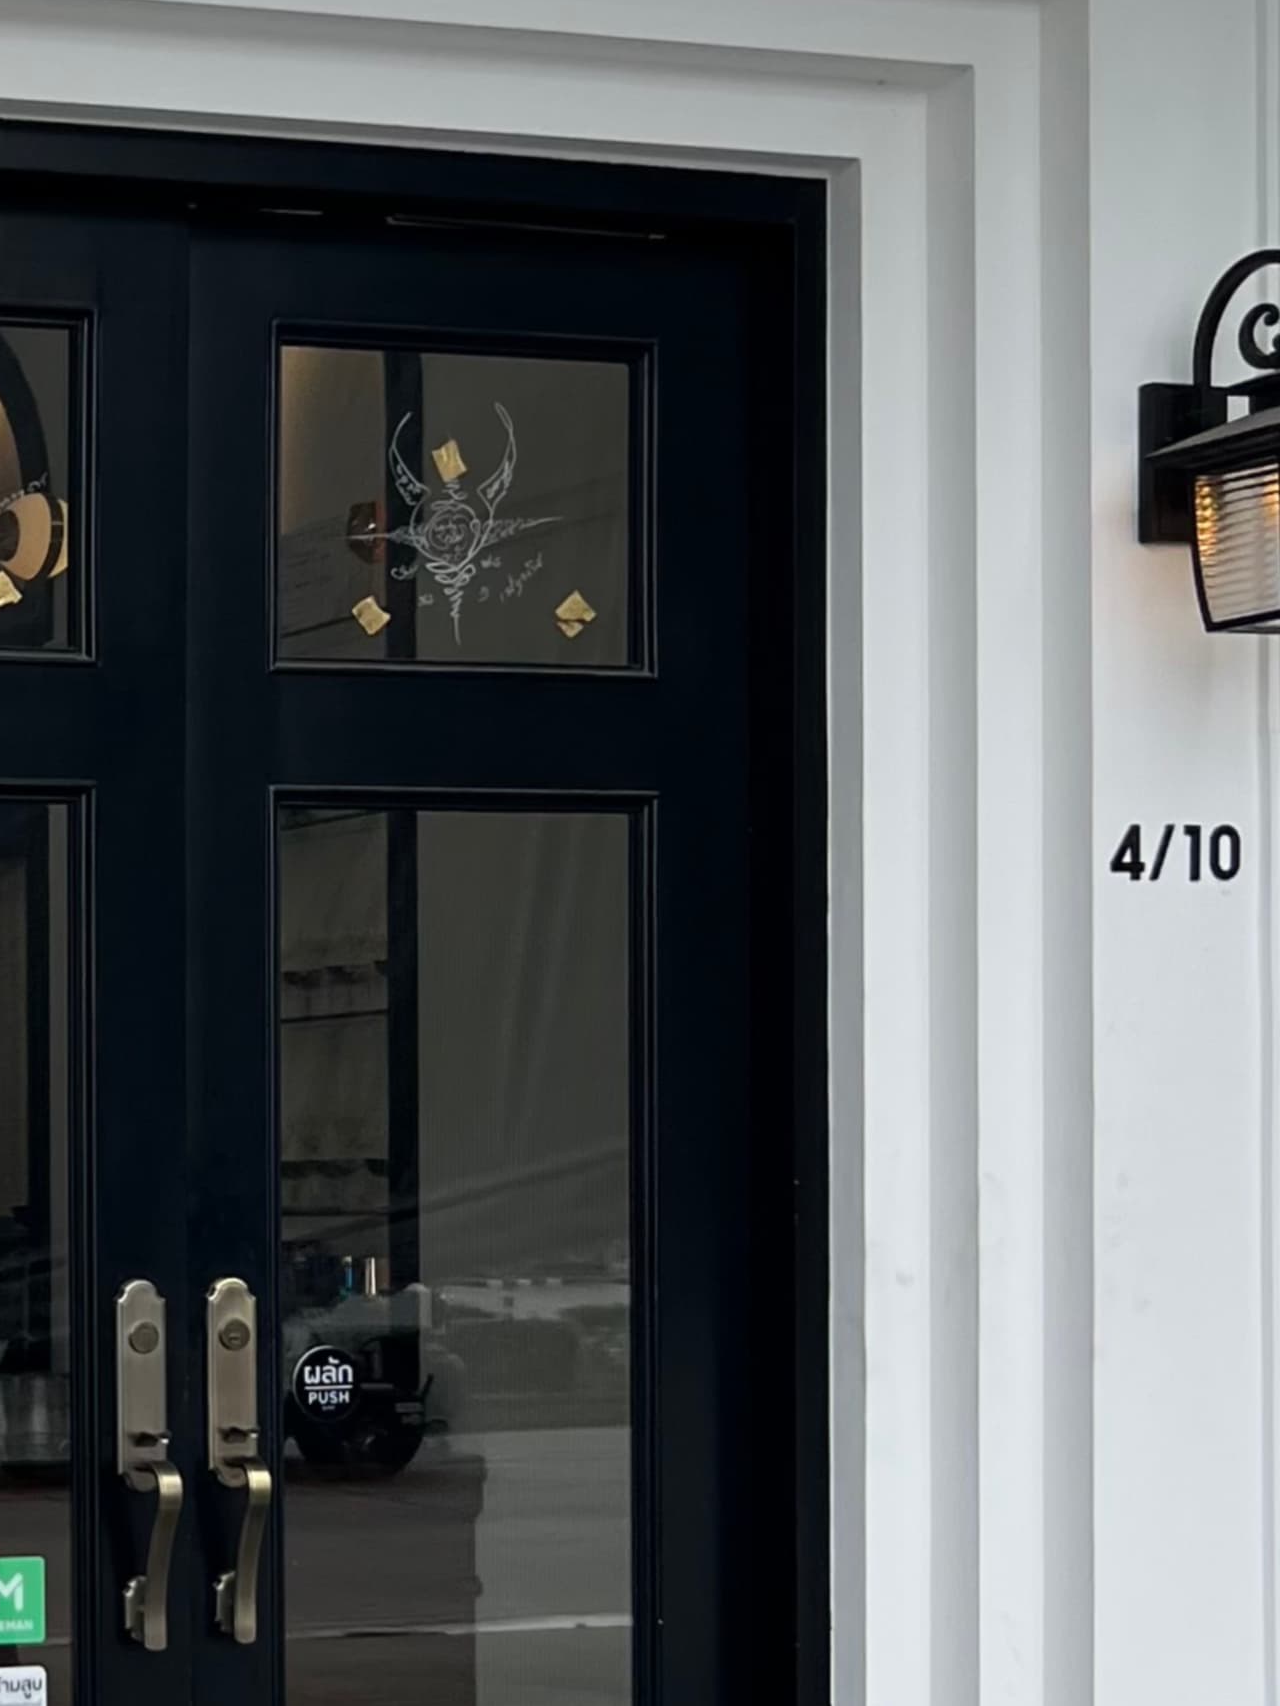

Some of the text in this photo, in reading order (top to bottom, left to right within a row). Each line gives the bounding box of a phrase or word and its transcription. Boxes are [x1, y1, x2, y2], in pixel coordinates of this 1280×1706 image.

[1109, 823, 1242, 883] 4/10
[303, 1355, 354, 1384] ผลัก
[308, 1390, 350, 1405] PUSH
